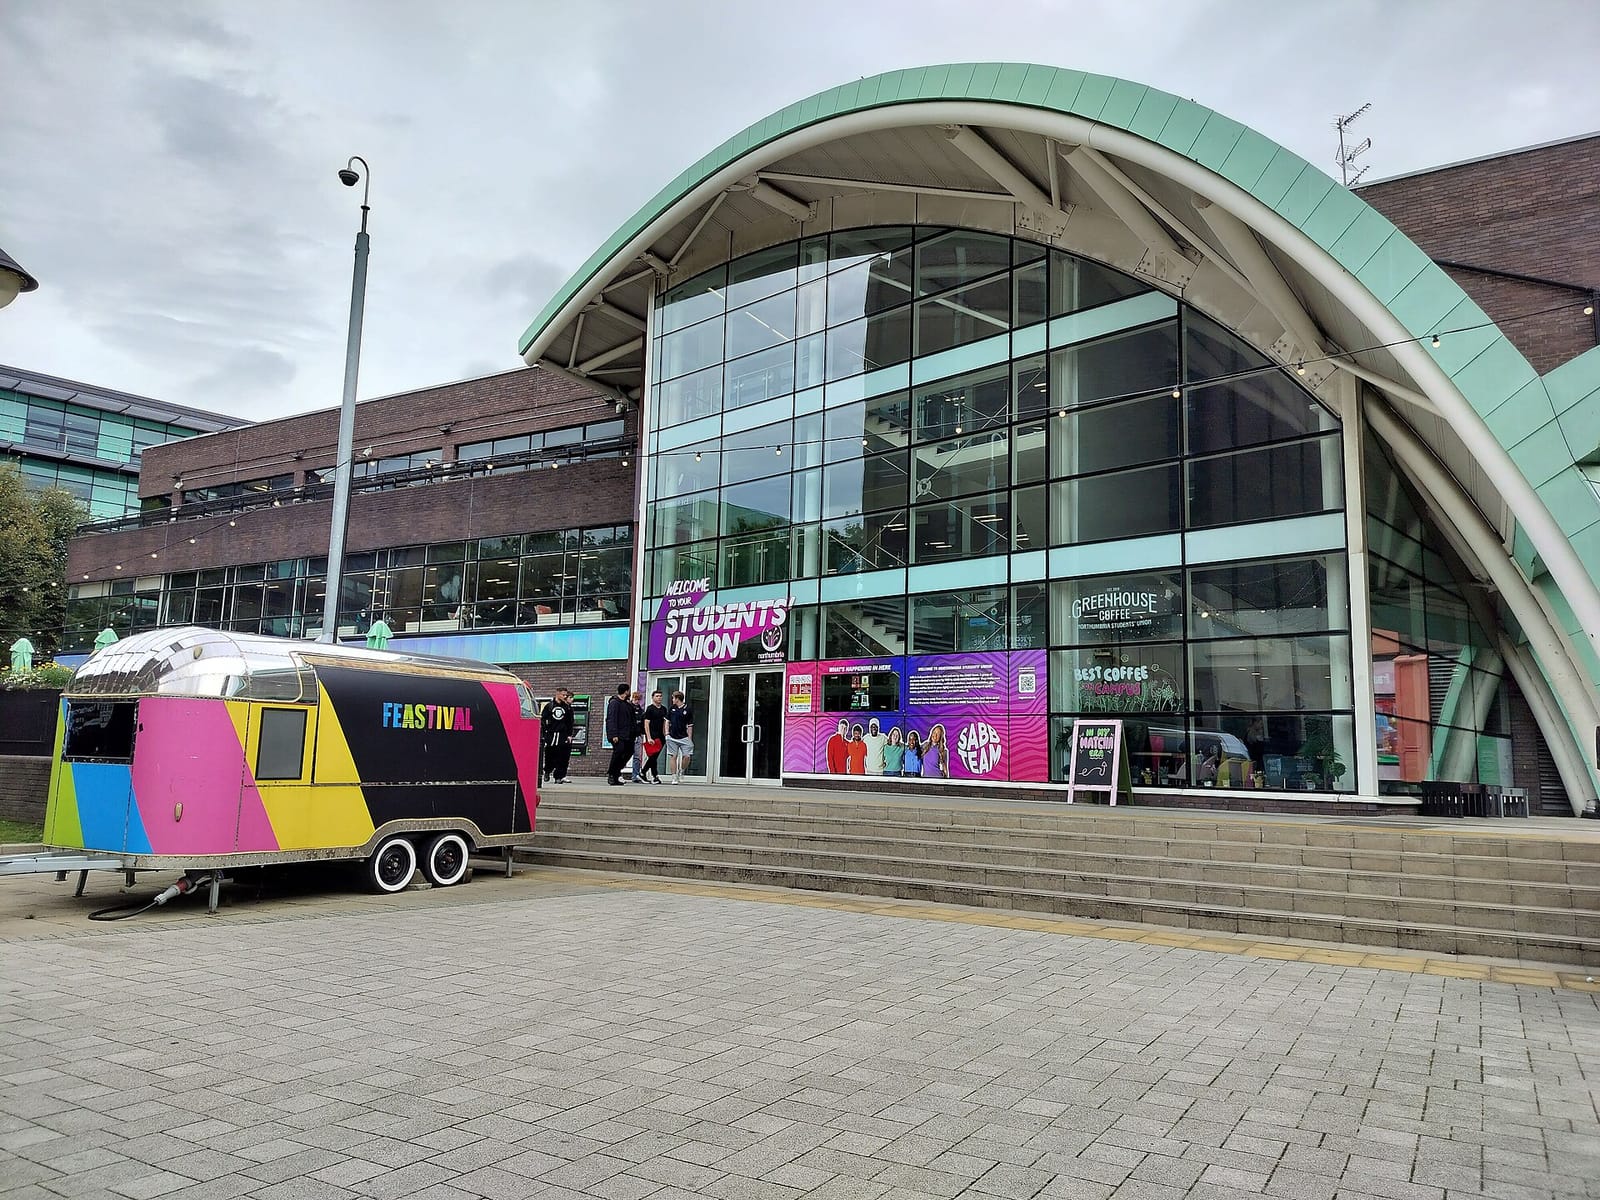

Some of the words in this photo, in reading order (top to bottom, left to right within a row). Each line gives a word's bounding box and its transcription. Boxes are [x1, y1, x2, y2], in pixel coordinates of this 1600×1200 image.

[665, 577, 711, 596] WELCOME
[668, 599, 677, 608] TO
[677, 597, 692, 606] YOUR
[1072, 592, 1158, 618] GREENHOUSE
[1099, 608, 1131, 621] COFFEE
[664, 632, 740, 663] UNION
[1074, 666, 1102, 681] BEST
[1103, 665, 1149, 682] COFFEE
[1094, 682, 1141, 696] CAMPUS
[382, 702, 474, 731] FEASTIVAL
[958, 722, 1001, 752] SABB
[1086, 728, 1095, 737] IN
[1097, 727, 1111, 737] MY
[1080, 736, 1114, 750] MATCHA
[957, 743, 1002, 776] TEAM
